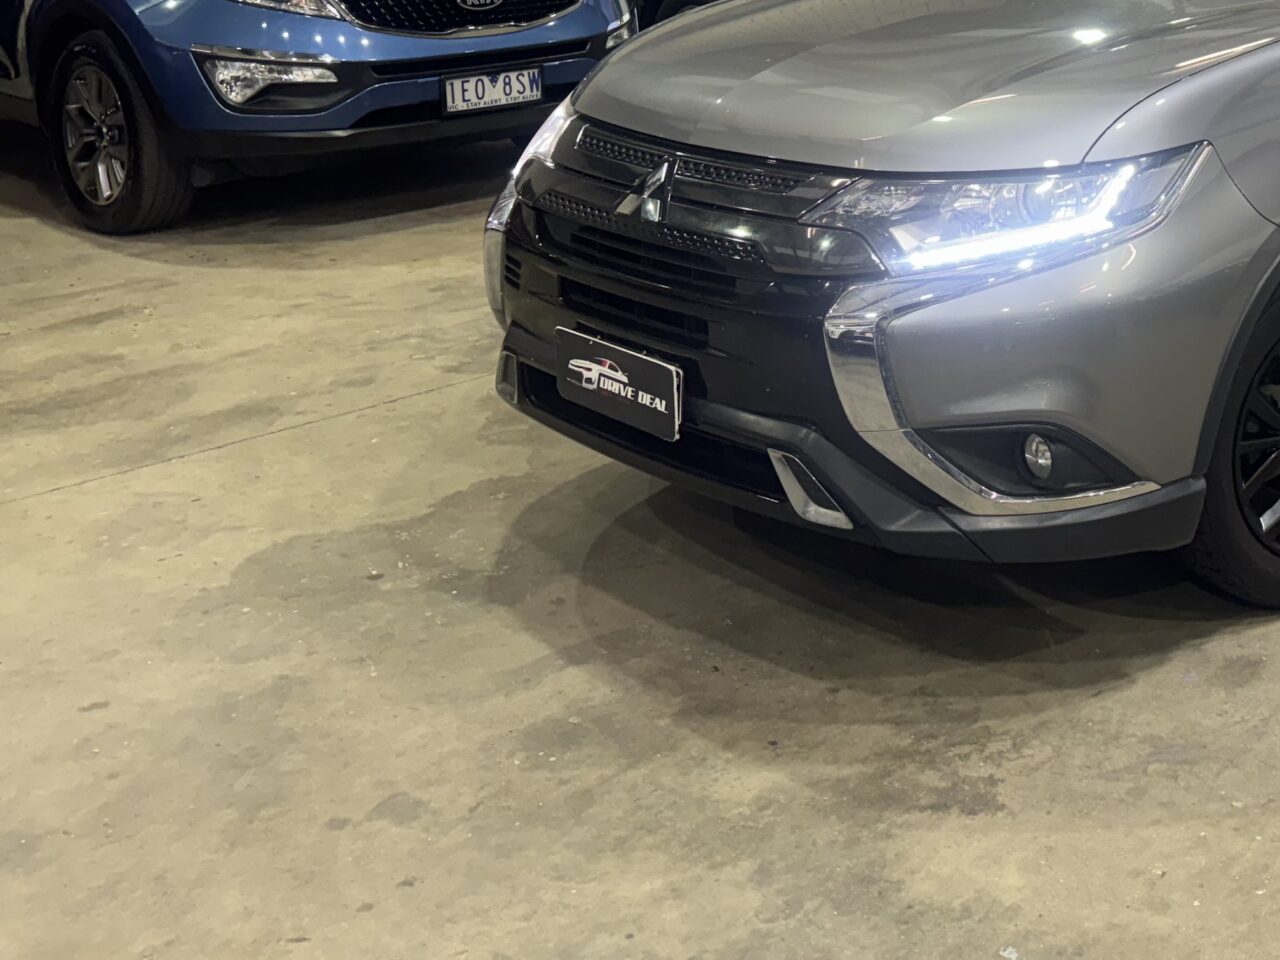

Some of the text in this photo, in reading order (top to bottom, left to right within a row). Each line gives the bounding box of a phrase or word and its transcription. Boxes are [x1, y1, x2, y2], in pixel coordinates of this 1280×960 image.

[503, 71, 541, 96] 8SW
[483, 98, 502, 106] ALERT
[599, 376, 636, 400] DRIVE
[637, 390, 668, 414] DEAL
